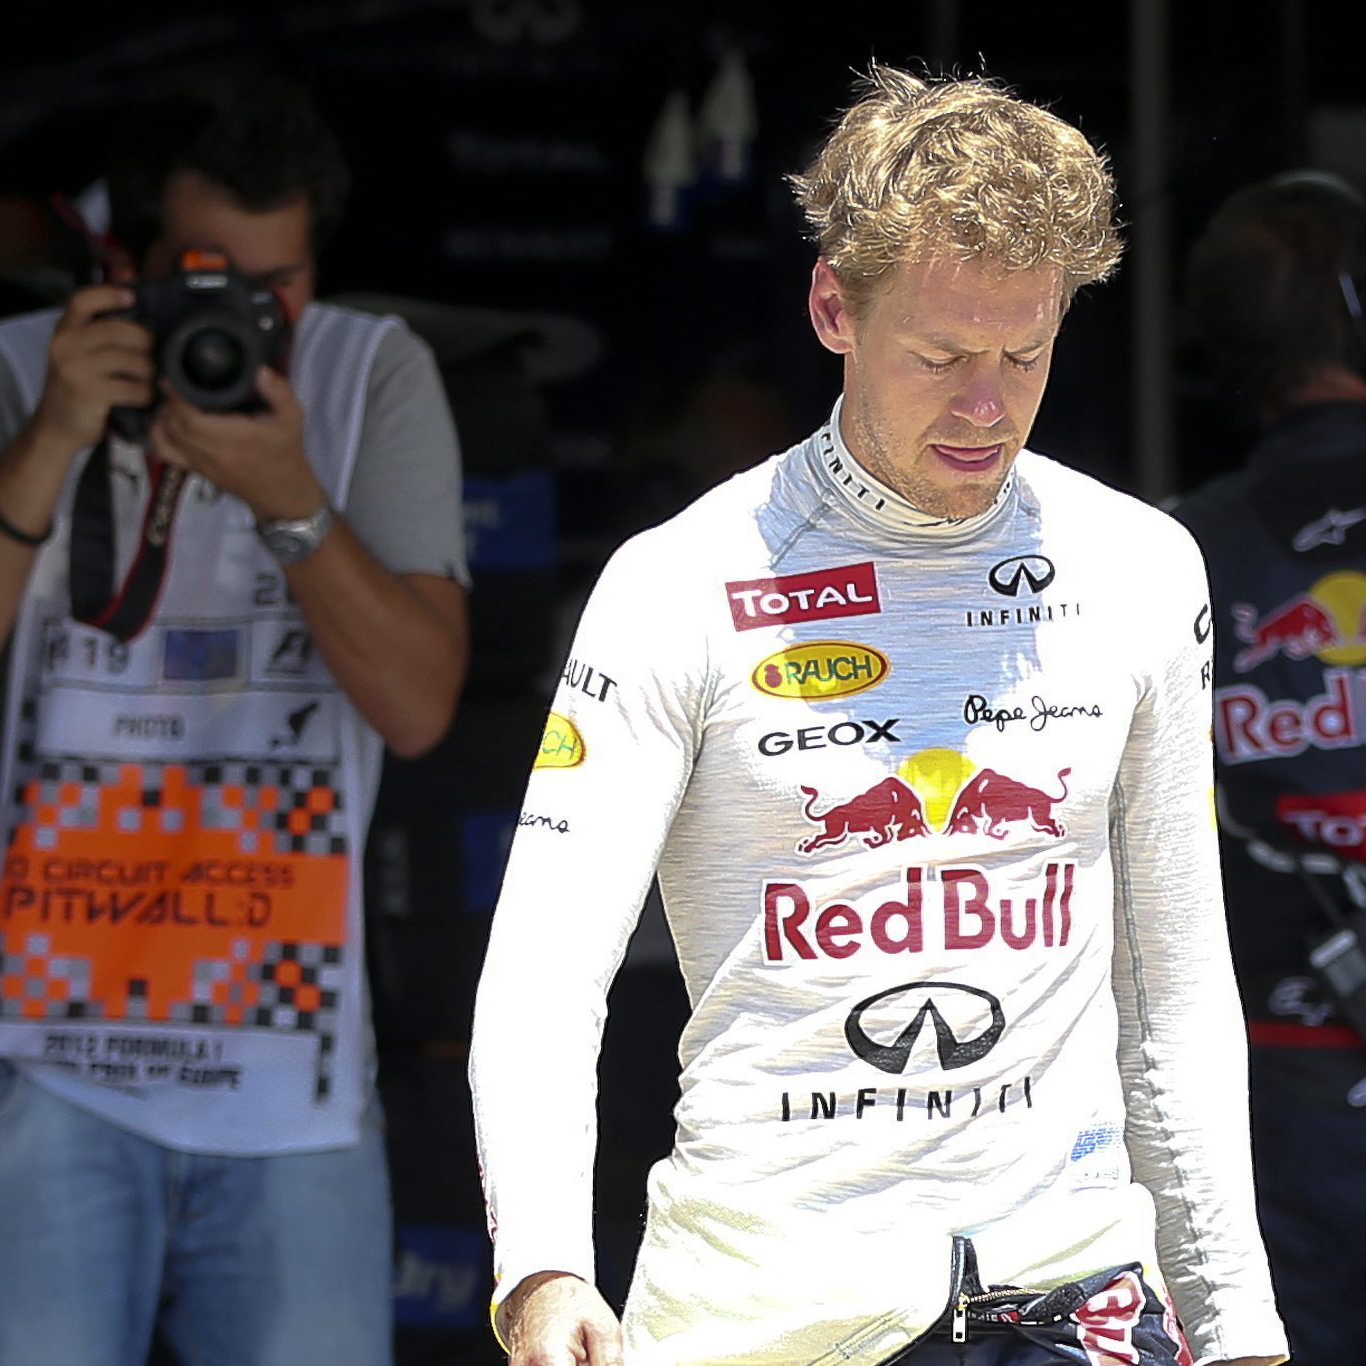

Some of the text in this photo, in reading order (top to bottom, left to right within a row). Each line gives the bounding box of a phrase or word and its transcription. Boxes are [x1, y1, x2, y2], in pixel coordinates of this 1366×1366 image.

[731, 583, 874, 618] TOTAL
[965, 602, 1081, 628] INFINITI
[784, 654, 874, 686] RAUCH
[963, 693, 1104, 734] Pepe Jeans
[1217, 672, 1357, 758] Red
[757, 718, 902, 757] GEOX
[42, 858, 170, 886] CIRCUIT
[181, 859, 295, 888] ACCESS
[4, 886, 229, 928] PITWALL
[764, 862, 1076, 961] Red Bull
[780, 1075, 1033, 1123] INFINITI
